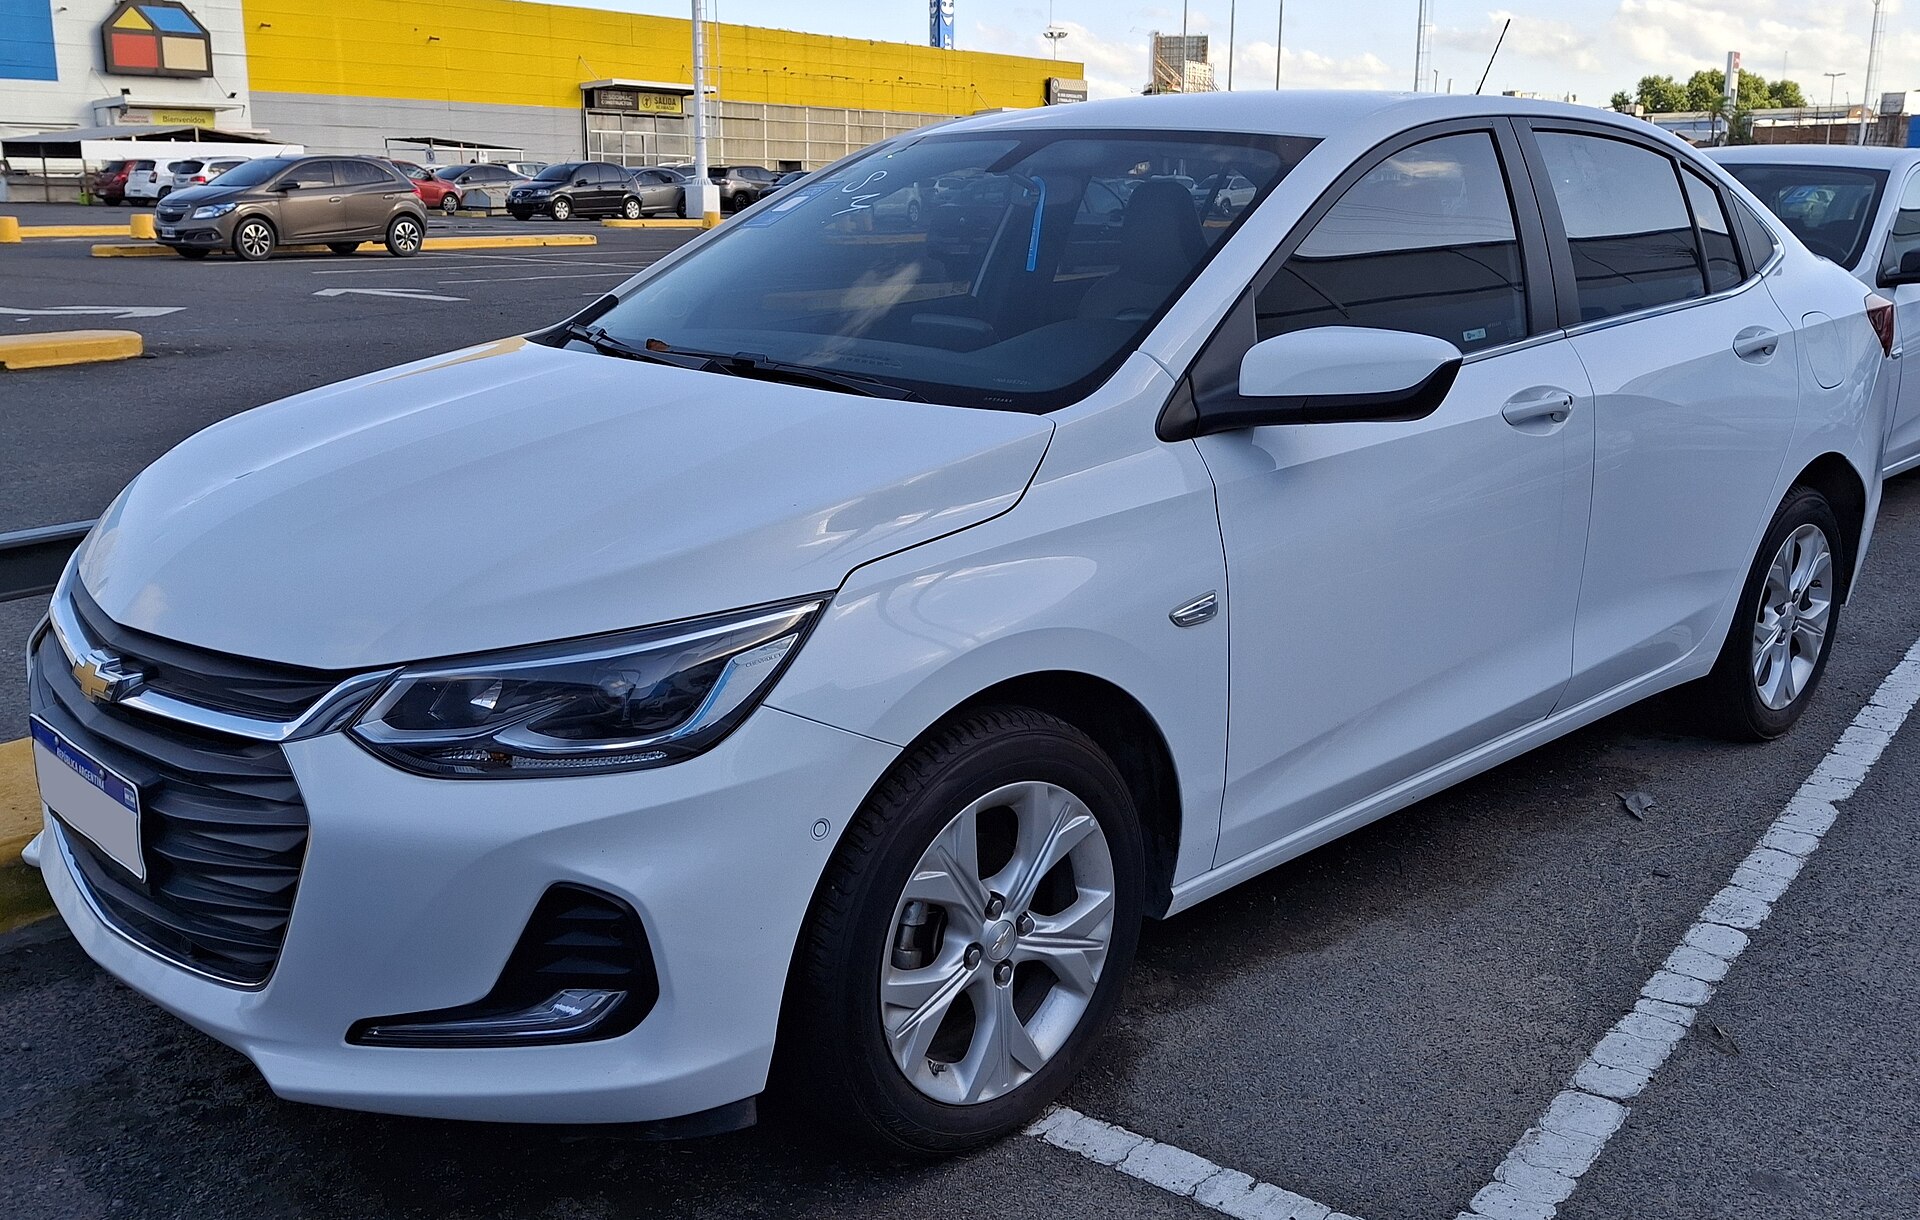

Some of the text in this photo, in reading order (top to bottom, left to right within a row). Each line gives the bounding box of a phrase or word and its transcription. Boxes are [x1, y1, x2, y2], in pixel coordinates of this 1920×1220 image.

[653, 96, 677, 106] SALIDA
[162, 115, 206, 124] Bienvenidos
[78, 764, 105, 791] ARGENTINA
